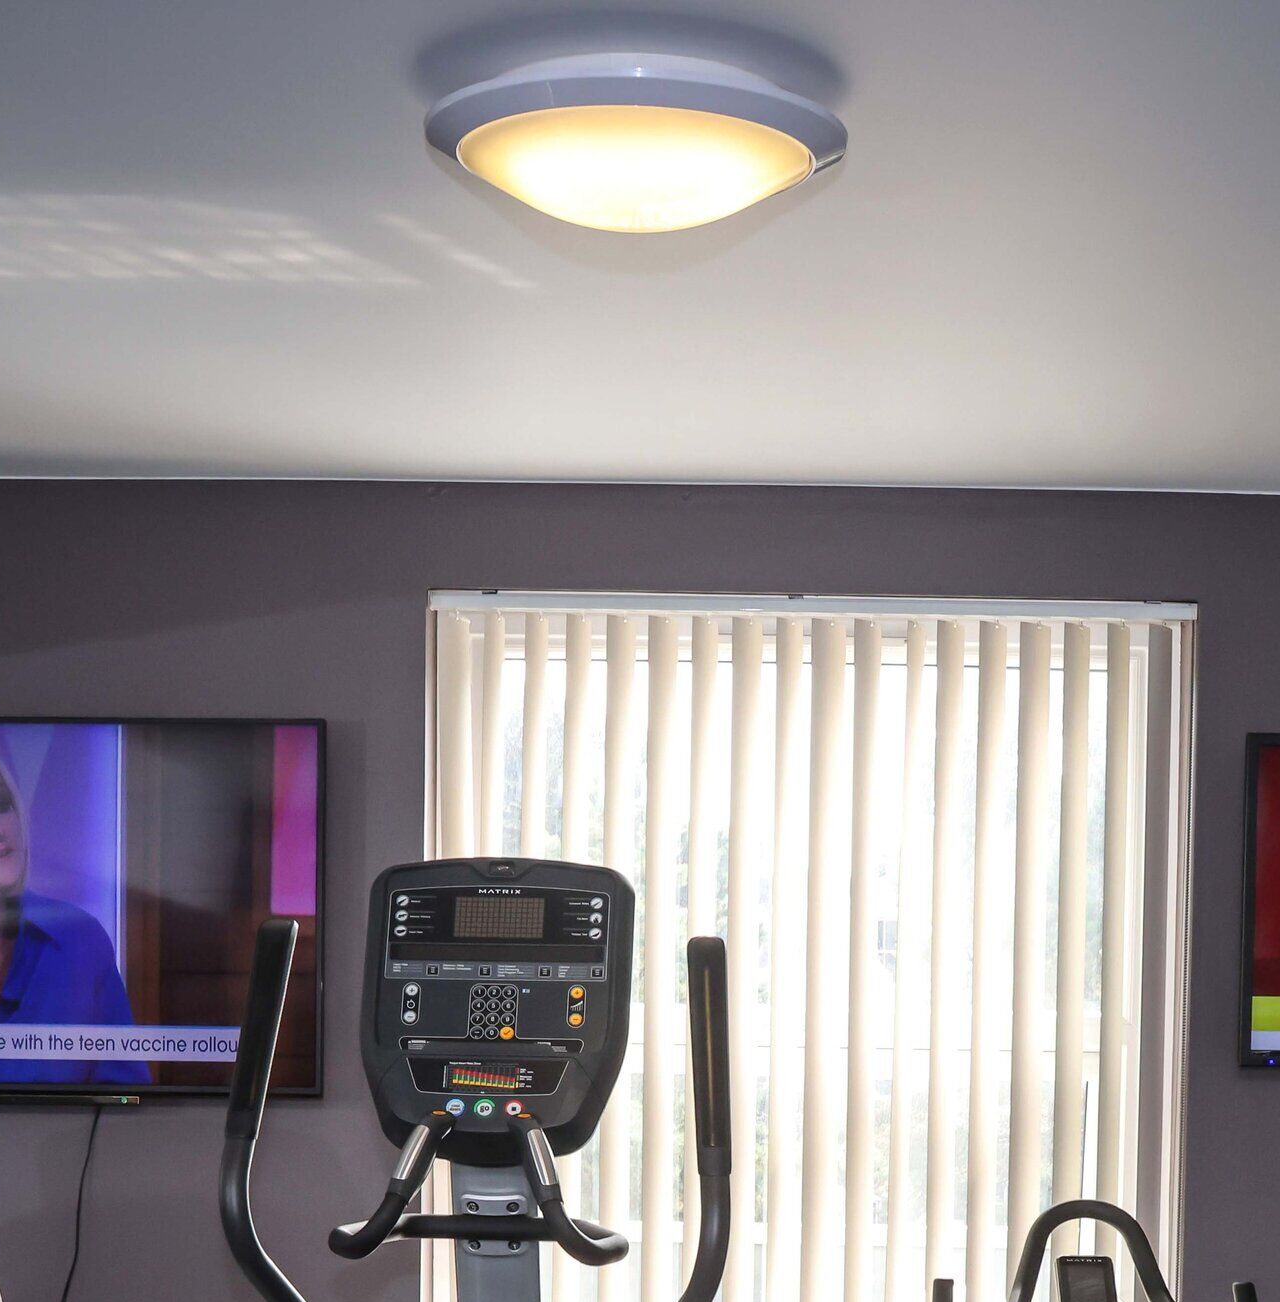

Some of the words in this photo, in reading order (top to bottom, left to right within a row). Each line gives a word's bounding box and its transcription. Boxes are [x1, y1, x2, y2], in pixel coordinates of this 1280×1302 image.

[478, 888, 521, 896] MATRIX
[11, 1033, 43, 1051] with
[48, 1034, 74, 1051] the
[79, 1034, 115, 1052] teen
[119, 1035, 187, 1053] vaccine
[193, 1036, 238, 1053] rollou
[479, 1105, 490, 1113] go
